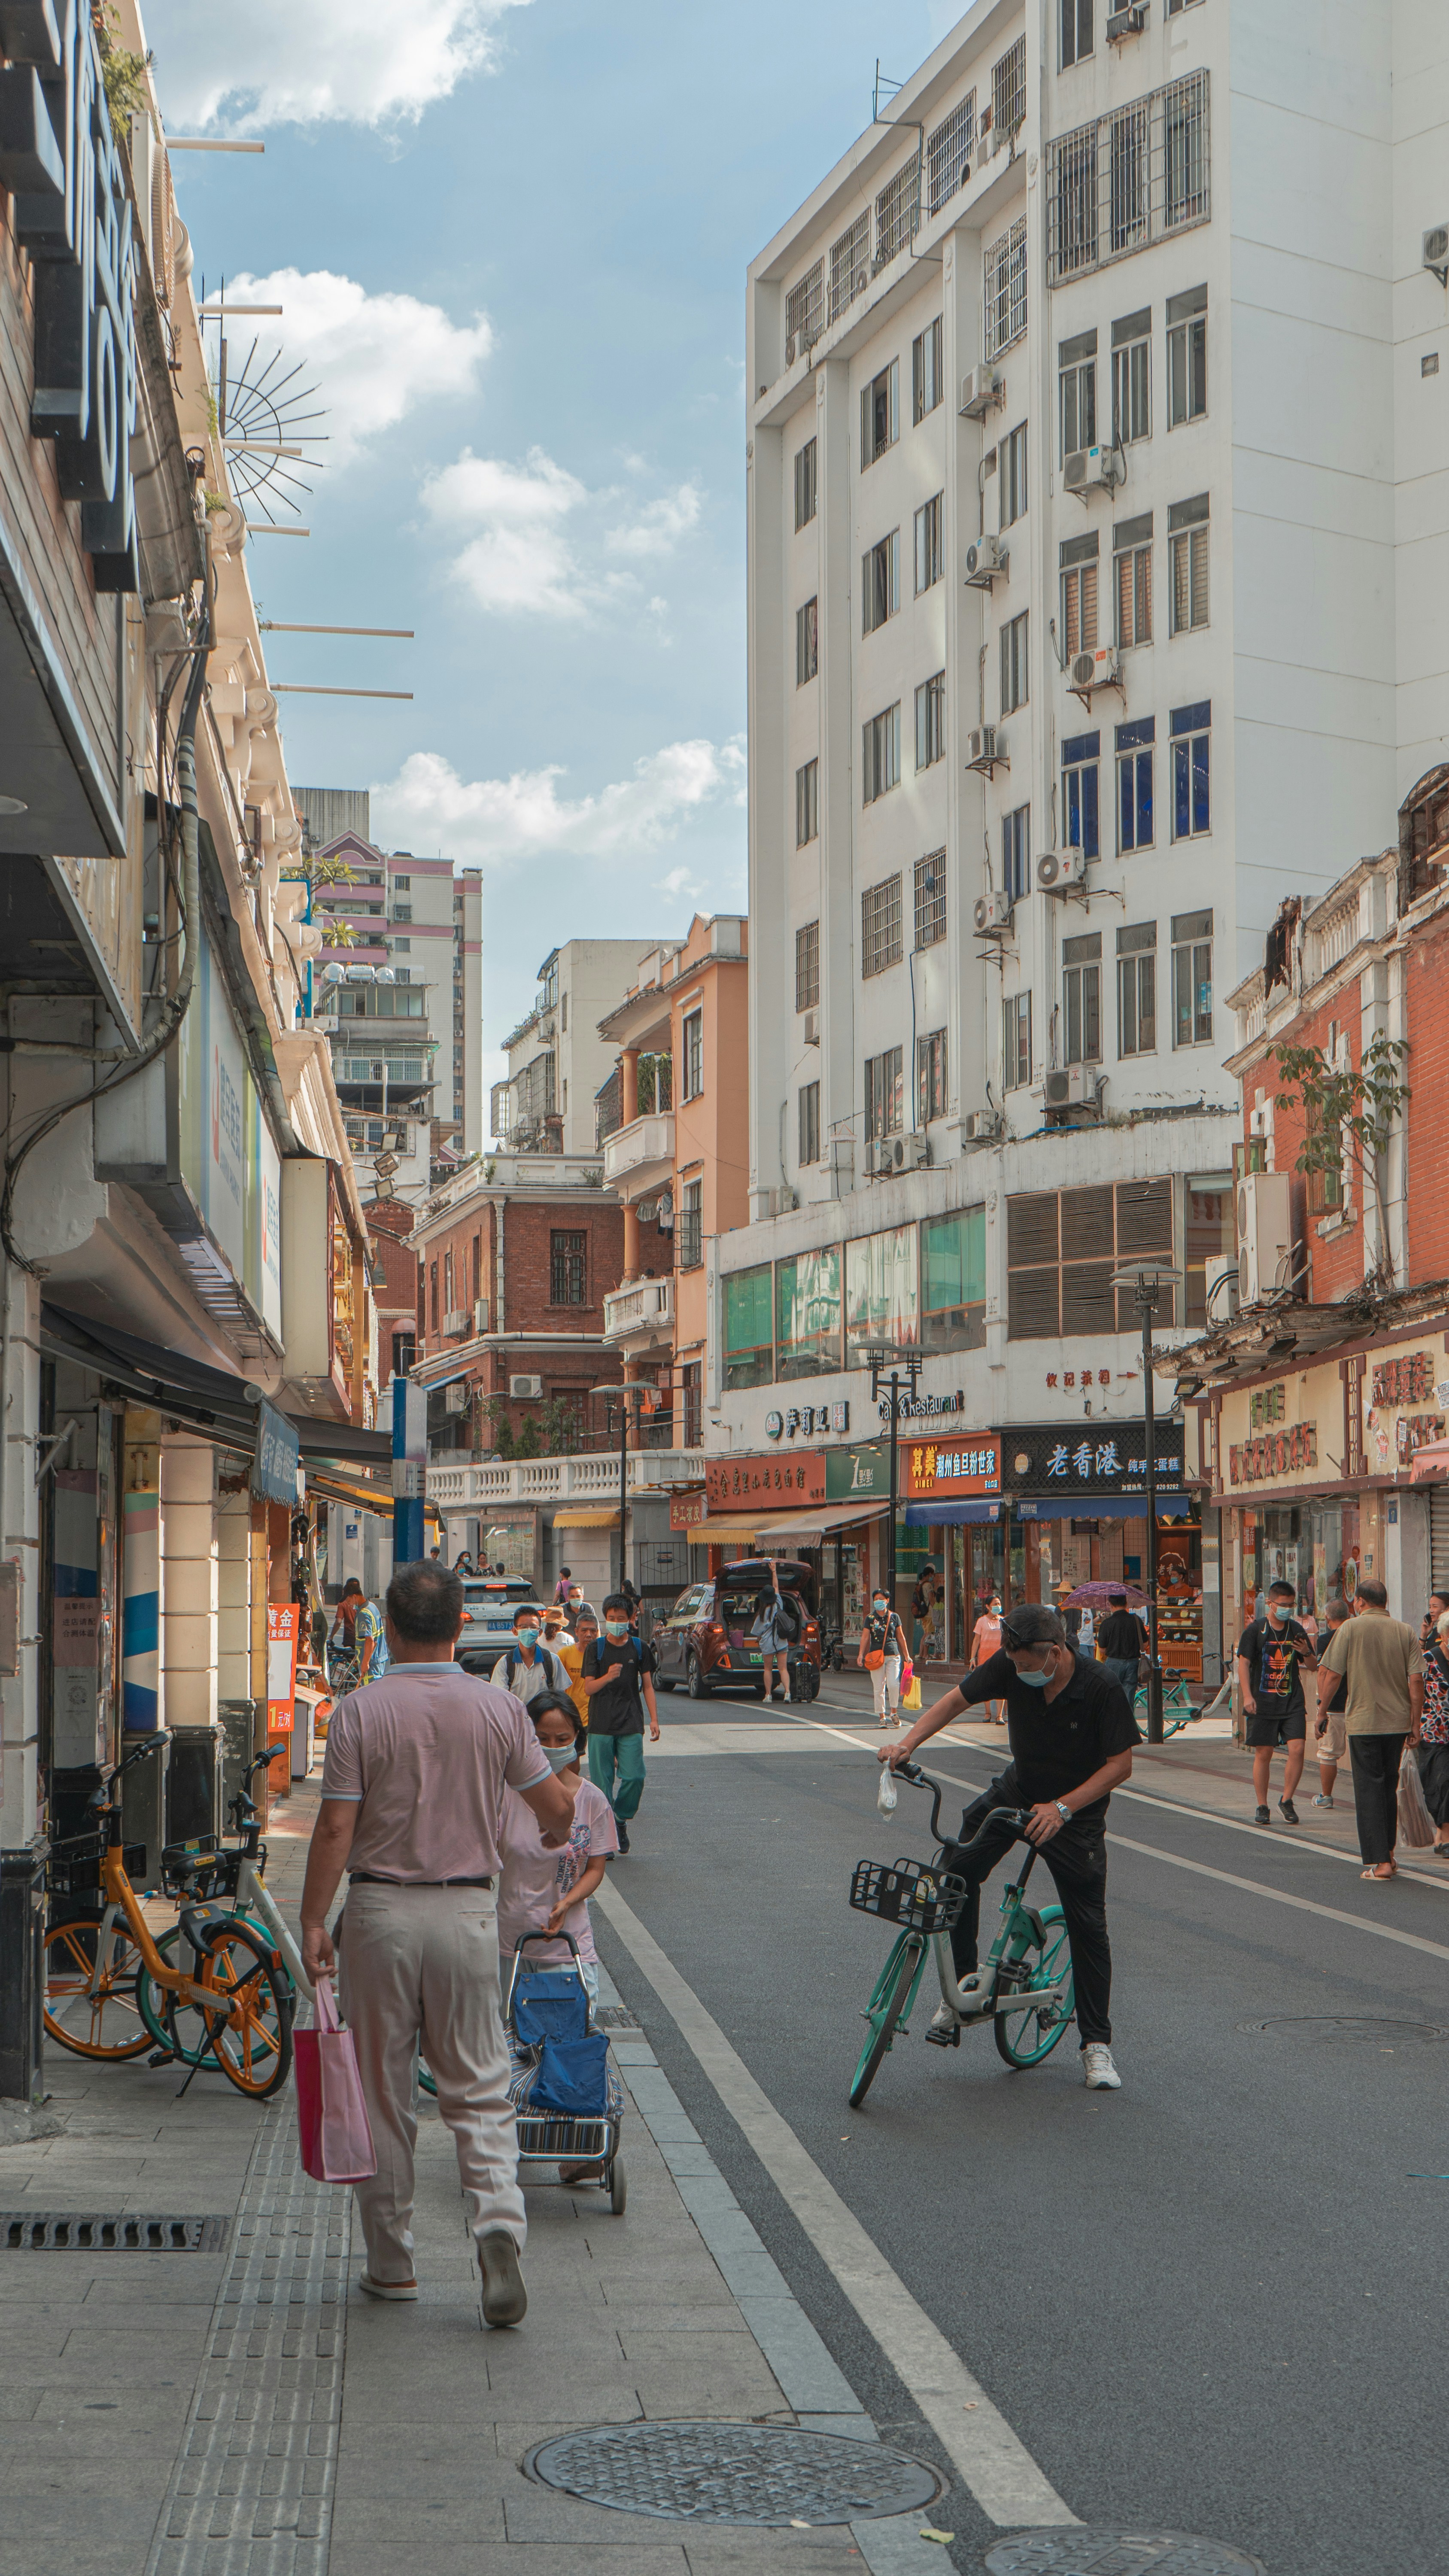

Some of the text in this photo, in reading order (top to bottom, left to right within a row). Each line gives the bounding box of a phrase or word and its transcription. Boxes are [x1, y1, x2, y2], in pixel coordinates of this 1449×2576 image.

[1045, 1369, 1110, 1387] 伙记茶档
[900, 1397, 908, 1417] &
[909, 1390, 964, 1417] Restaurant
[786, 1406, 829, 1438] 萨莉亚
[936, 1449, 995, 1478] 潮州鱼旦粉世家
[1047, 1441, 1123, 1479] 老香港
[1128, 1458, 1179, 1474] 纯手蛋糕
[915, 1479, 933, 1488] QIMEI
[985, 1479, 998, 1488] 东山口店
[63, 1618, 96, 1626] 进店请配
[556, 1855, 567, 1885] SCHOOL
[560, 1858, 574, 1893] TRAINING
